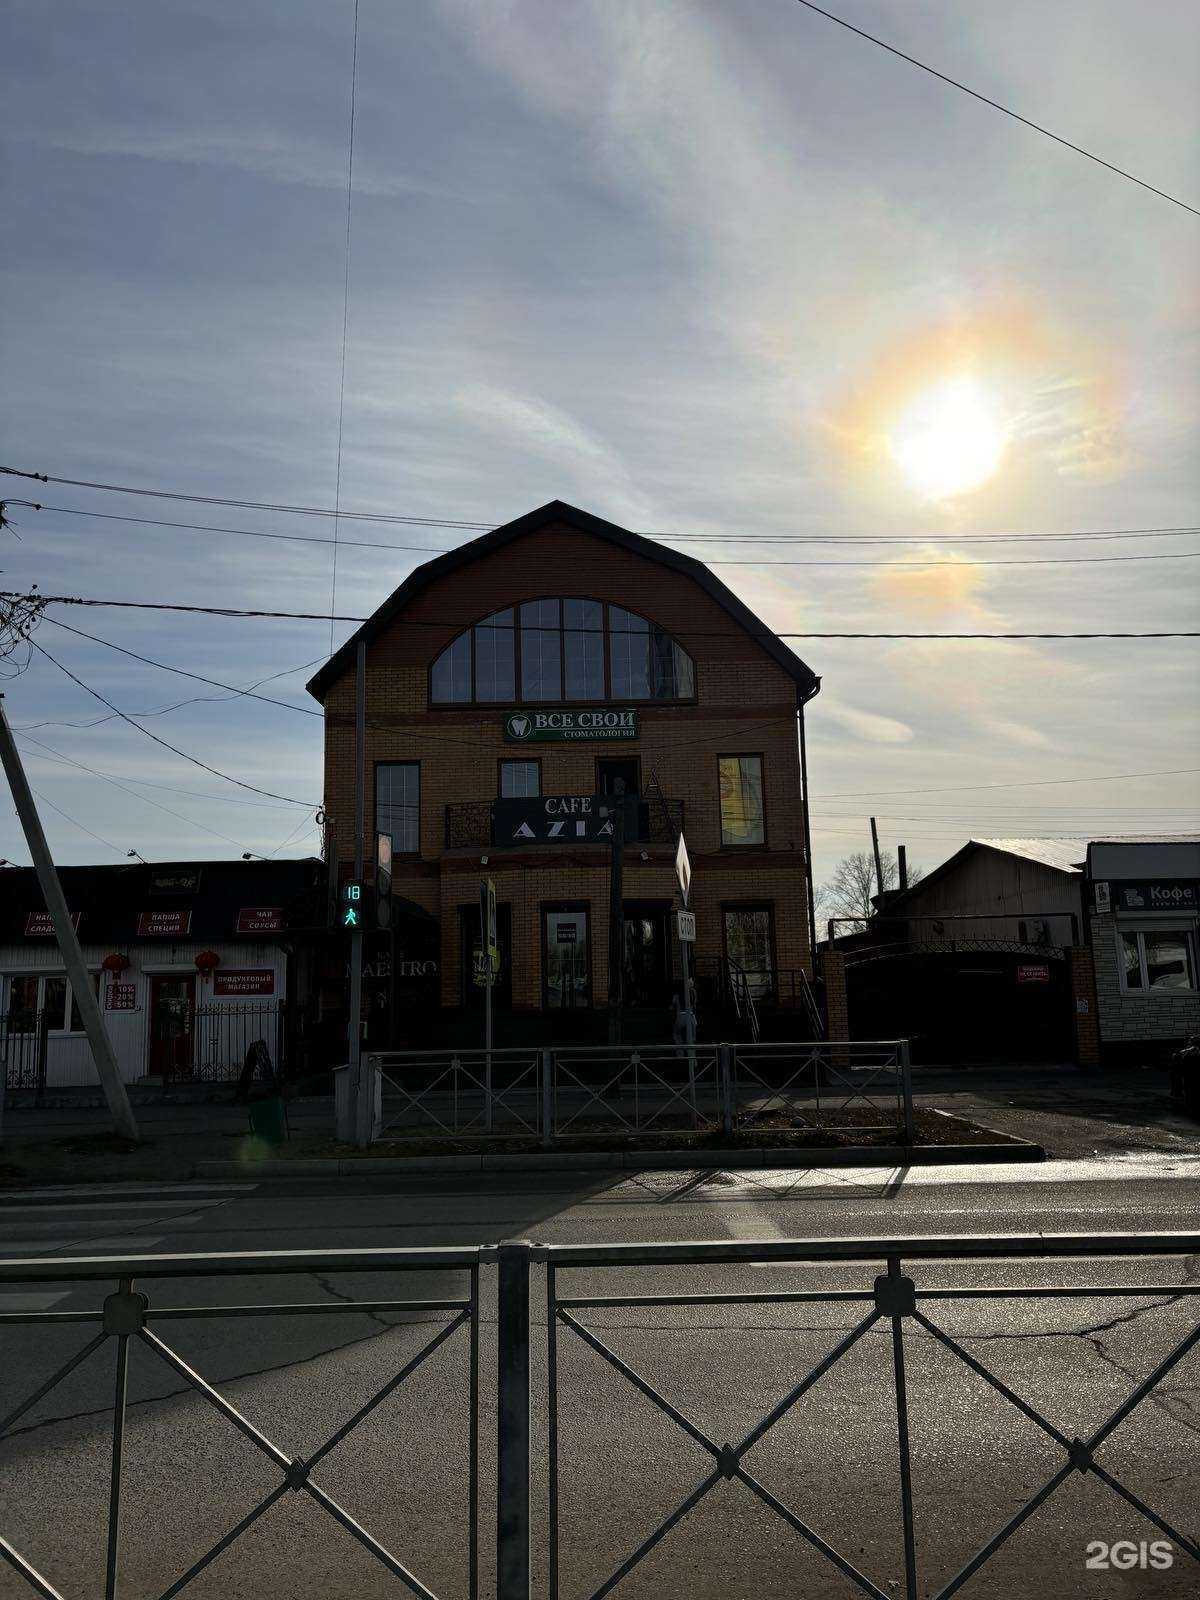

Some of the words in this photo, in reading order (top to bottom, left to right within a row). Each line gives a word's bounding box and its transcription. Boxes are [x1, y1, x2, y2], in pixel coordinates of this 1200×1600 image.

[535, 713, 574, 729] ВСЕ
[564, 729, 635, 738] СТОМАТОЛОГИЯ
[544, 798, 592, 814] CAFE
[512, 820, 615, 838] AZIA
[348, 885, 361, 900] 18
[1150, 886, 1193, 901] Кофе
[218, 975, 271, 984] ПРОДУКТОВЫЙ
